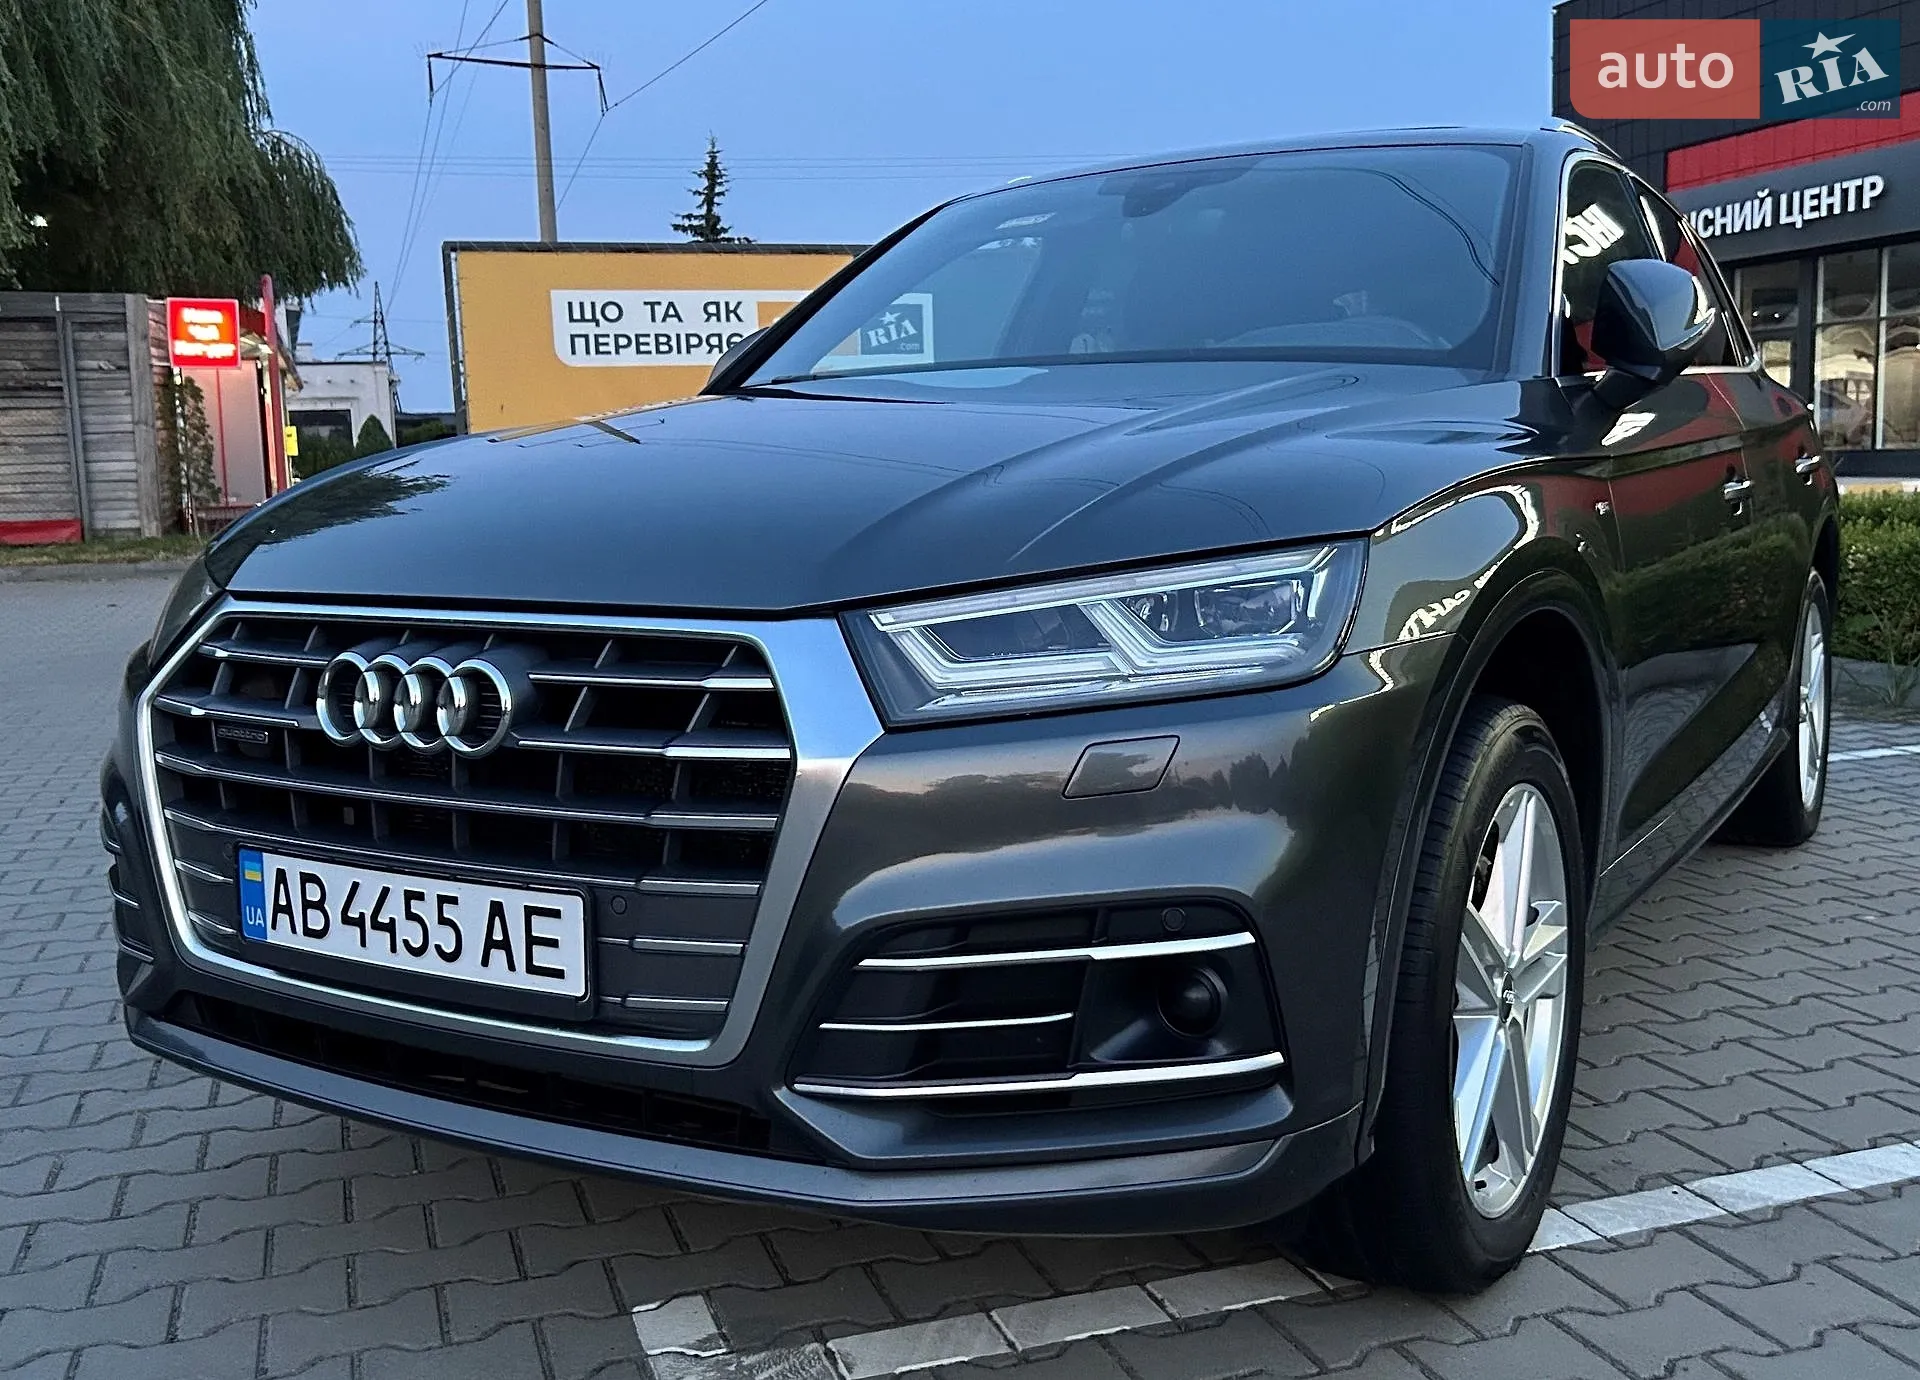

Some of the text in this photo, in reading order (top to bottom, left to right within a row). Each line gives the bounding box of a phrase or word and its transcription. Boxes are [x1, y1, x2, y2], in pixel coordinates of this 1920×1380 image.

[1683, 188, 1773, 238] ІСНИЙ
[1779, 174, 1885, 229] ЦЕНТР
[567, 301, 744, 326] ЩО ТА ЯК
[246, 906, 264, 927] UA
[270, 867, 566, 980] AB 4455 AE
